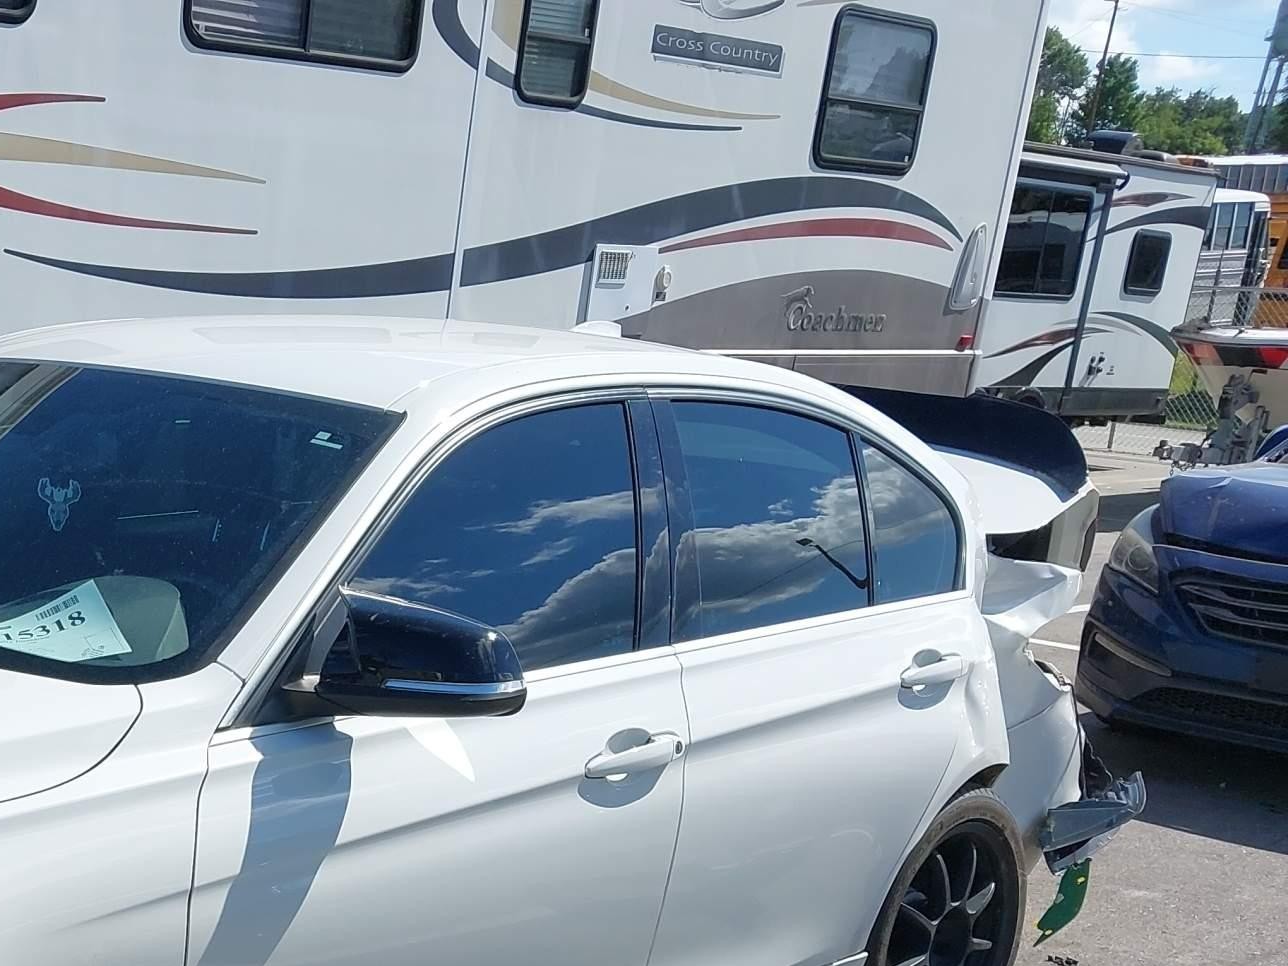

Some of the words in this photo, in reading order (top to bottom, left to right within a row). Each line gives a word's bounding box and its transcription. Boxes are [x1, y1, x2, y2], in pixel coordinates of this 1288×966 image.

[656, 32, 705, 51] Cross
[709, 41, 779, 66] Country
[786, 303, 888, 333] Coachmen
